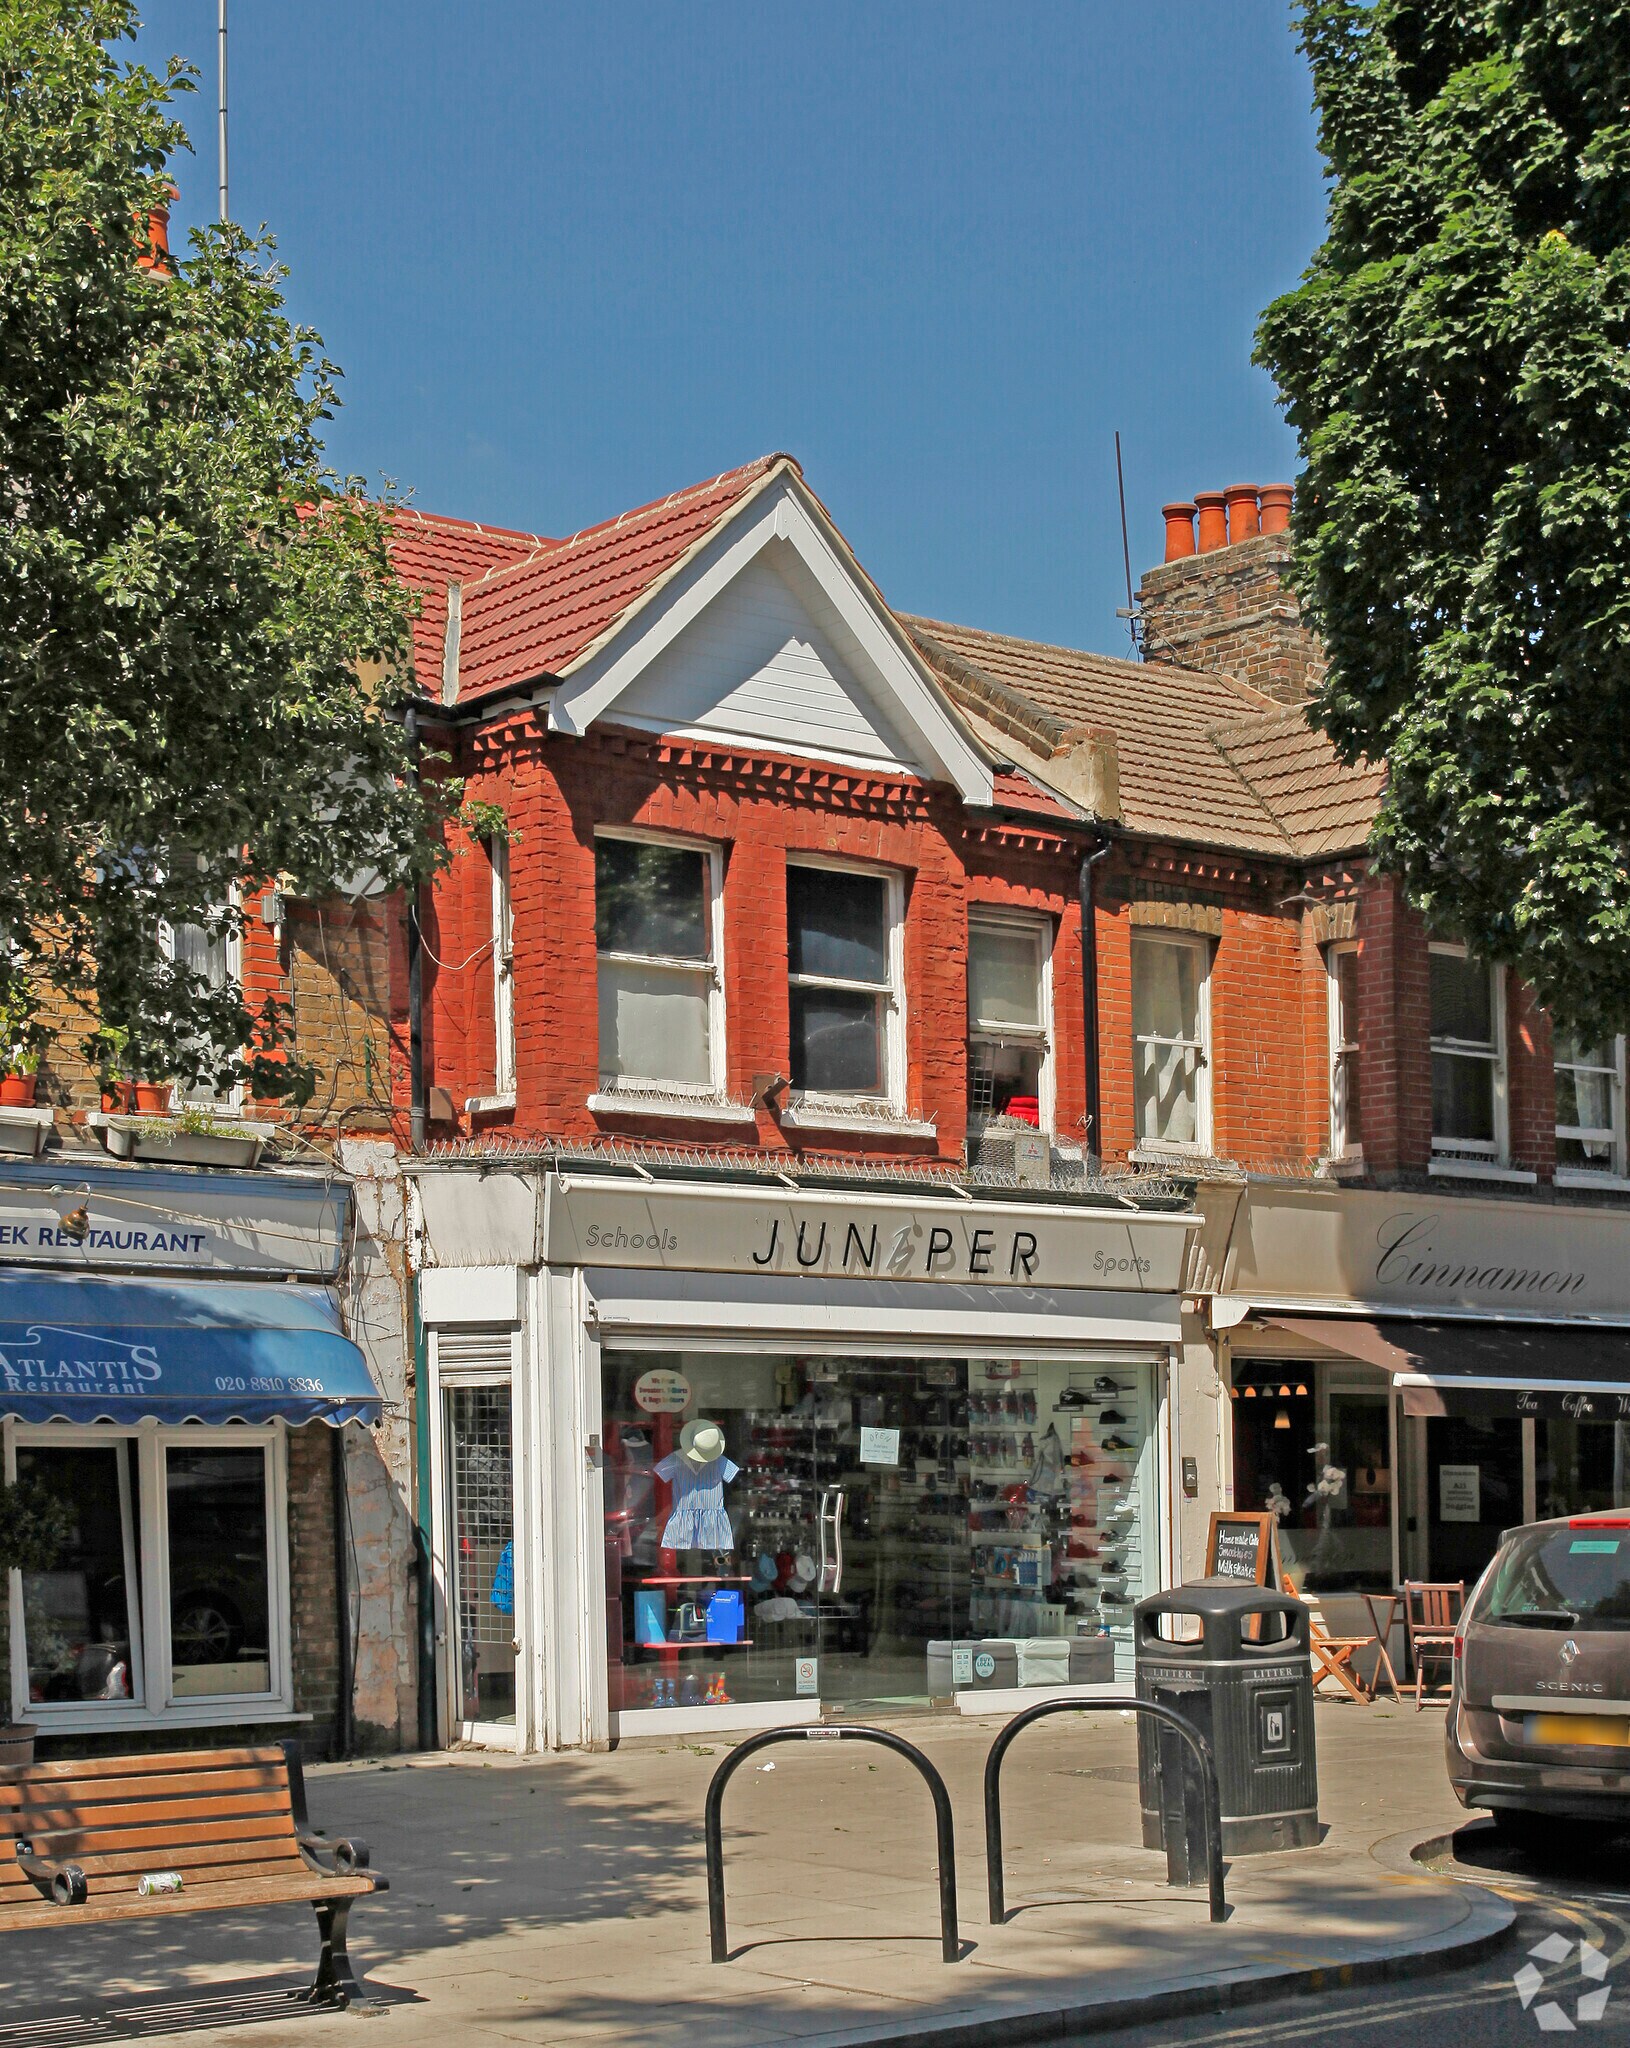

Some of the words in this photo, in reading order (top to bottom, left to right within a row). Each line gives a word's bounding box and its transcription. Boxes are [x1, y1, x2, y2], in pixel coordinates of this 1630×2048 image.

[38, 1227, 206, 1253] RESTAURANT
[585, 1224, 678, 1250] Schools
[1092, 1250, 1151, 1276] Sports
[1375, 1212, 1589, 1295] Cinnamon
[5, 1376, 145, 1394] Restaurant
[215, 1376, 285, 1392] 020-8810
[287, 1377, 324, 1392] 8836
[1517, 1391, 1539, 1410] Tea
[1561, 1392, 1594, 1418] Coffee
[1152, 1668, 1193, 1679] LITTER
[1253, 1667, 1294, 1679] LITTER
[1535, 1680, 1603, 1693] SCENIC
